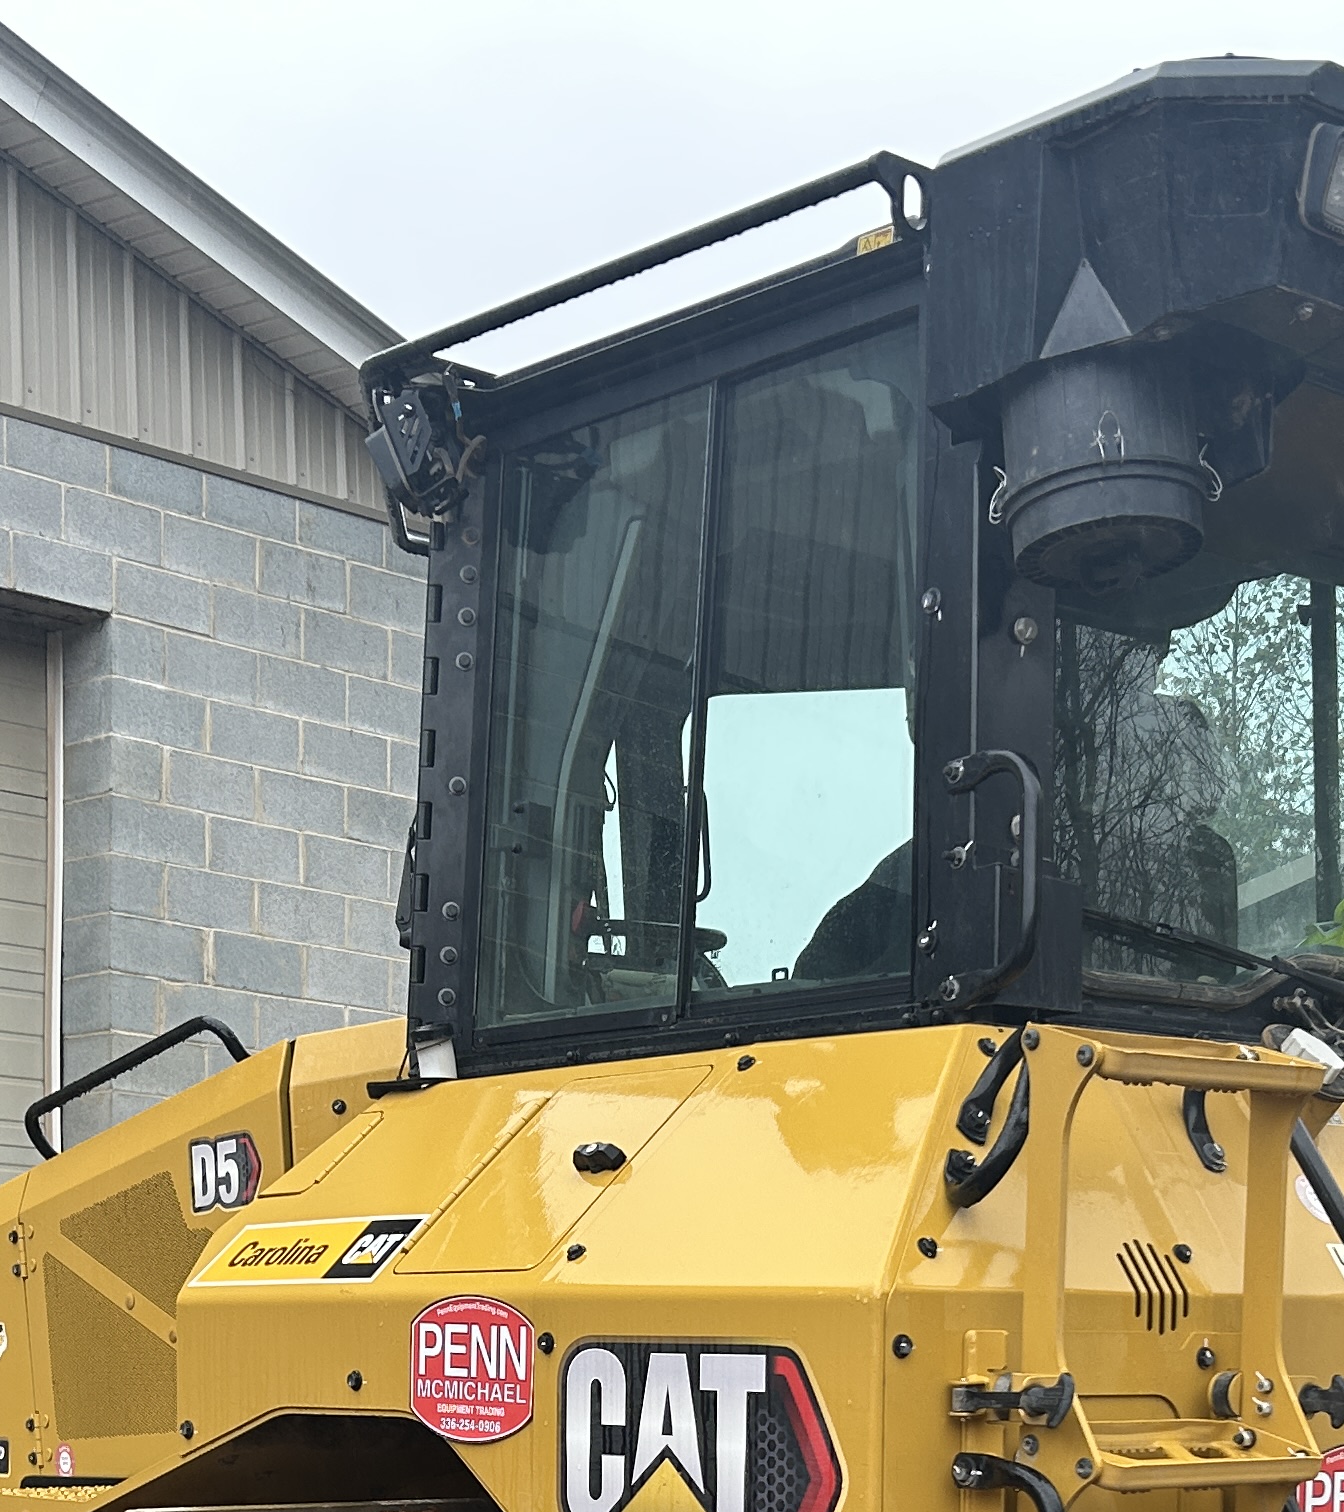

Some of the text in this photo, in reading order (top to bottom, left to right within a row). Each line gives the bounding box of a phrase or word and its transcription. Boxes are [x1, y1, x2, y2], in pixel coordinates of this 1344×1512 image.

[191, 1138, 240, 1208] D5
[228, 1233, 404, 1268] Carolina CAT
[418, 1321, 527, 1381] PENN
[417, 1378, 527, 1404] MCMICHAEL
[437, 1402, 506, 1417] EQUIPMENT TRADING
[440, 1417, 501, 1434] 336-254-0906
